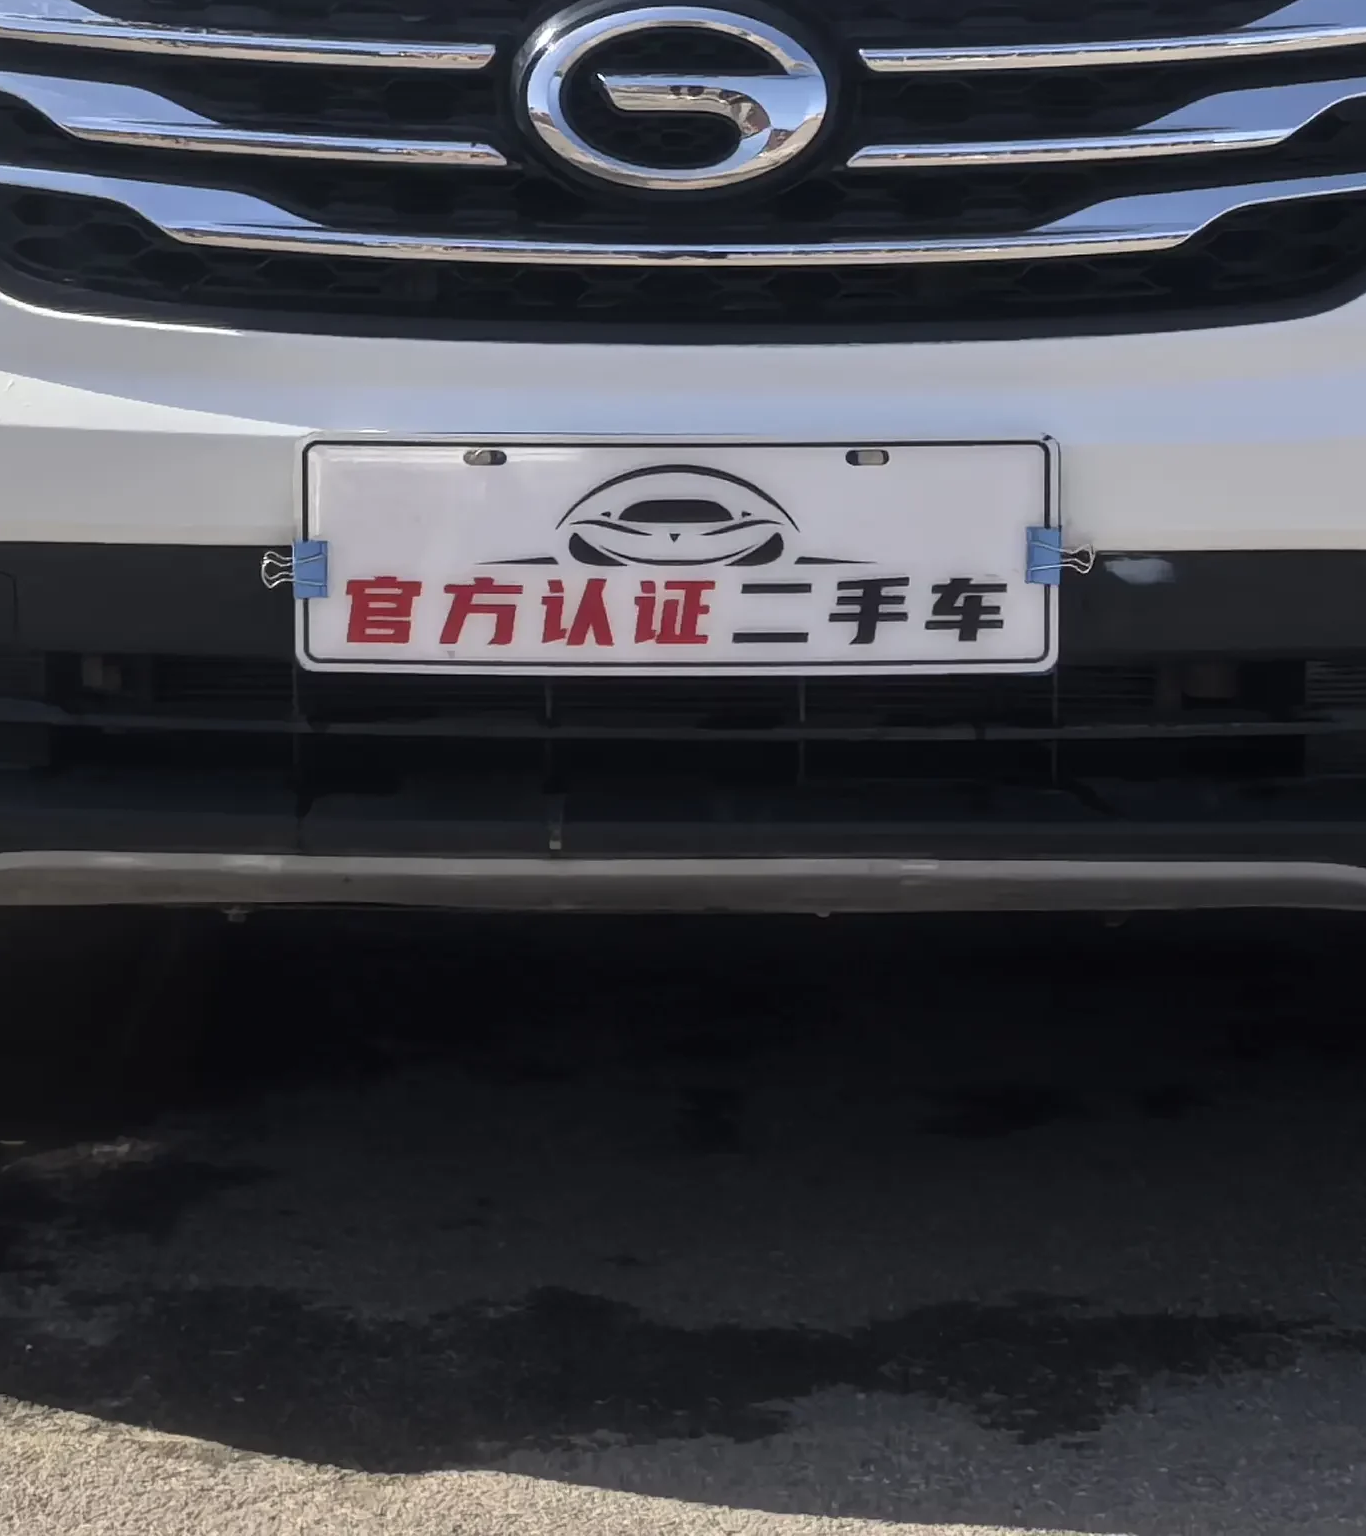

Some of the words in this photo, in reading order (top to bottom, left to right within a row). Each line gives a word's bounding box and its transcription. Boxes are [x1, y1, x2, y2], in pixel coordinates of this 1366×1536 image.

[345, 576, 1009, 646] 官方认证二手车
